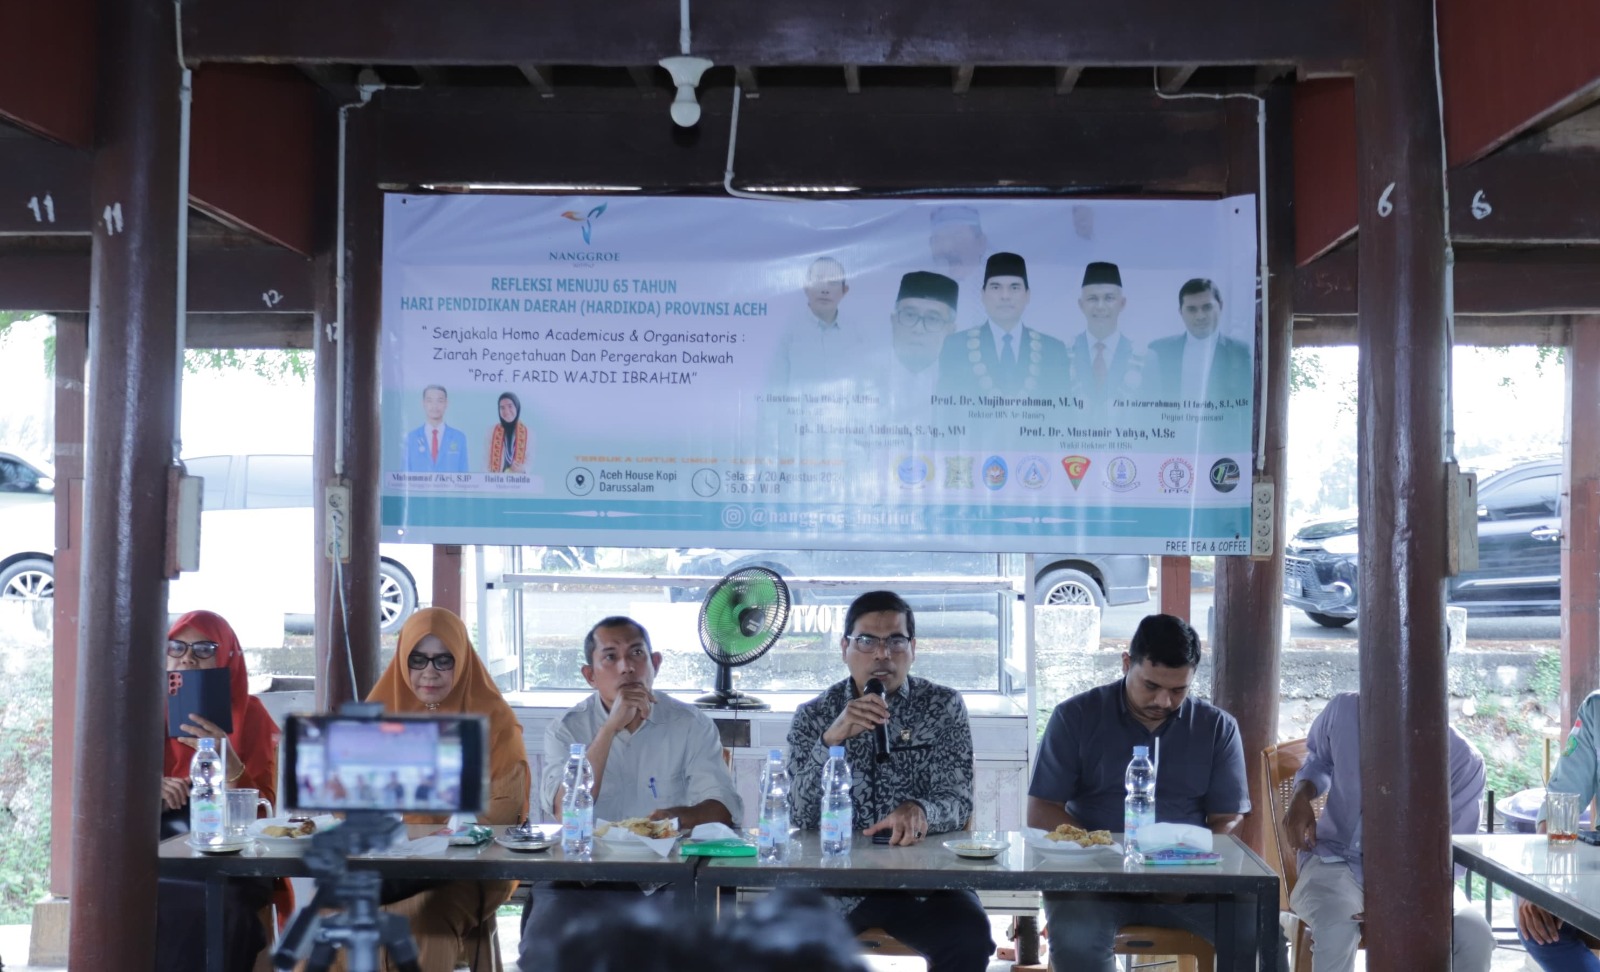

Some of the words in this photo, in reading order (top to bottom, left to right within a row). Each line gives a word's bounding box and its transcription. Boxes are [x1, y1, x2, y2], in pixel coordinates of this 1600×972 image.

[27, 192, 56, 223] 11
[1377, 182, 1395, 218] 6
[103, 202, 124, 236] 11
[549, 251, 620, 262] NANGGROE
[491, 277, 553, 293] REFLEKSI
[556, 278, 609, 293] MENUJU
[613, 278, 629, 293] 65
[633, 279, 677, 294] TAHUN
[400, 296, 434, 311] HARI
[437, 297, 520, 312] PENDIDIKAN
[524, 298, 576, 313] DAERAH
[580, 299, 661, 317] (HARDIKDA)
[665, 300, 729, 315] PROVINSI
[733, 301, 768, 316] ACEH
[432, 327, 498, 344] Senjakala
[502, 328, 540, 341] Homo
[545, 328, 625, 342] Academicus
[630, 330, 639, 342] &
[643, 329, 737, 346] Organisatoris
[432, 347, 478, 361] Ziarah
[482, 348, 566, 366] Pengetahuan
[571, 350, 597, 363] Dan
[600, 350, 677, 367] Pergerakan
[682, 351, 734, 364] Dakwah
[512, 369, 559, 383] FARID
[564, 370, 618, 384] WAJDI
[930, 394, 957, 406] Prof.
[959, 395, 976, 406] Dr.
[1019, 426, 1046, 438] Prof.
[1048, 427, 1064, 438] Dr.
[1067, 427, 1112, 438] Mustanir
[599, 469, 623, 480] Aceh
[625, 470, 654, 481] House
[656, 470, 677, 483] Kopi
[599, 482, 655, 493] Darussalam
[1165, 540, 1187, 552] FREE
[1191, 541, 1207, 552] TEA
[1210, 541, 1216, 552] &
[1218, 540, 1247, 552] COFFEE
